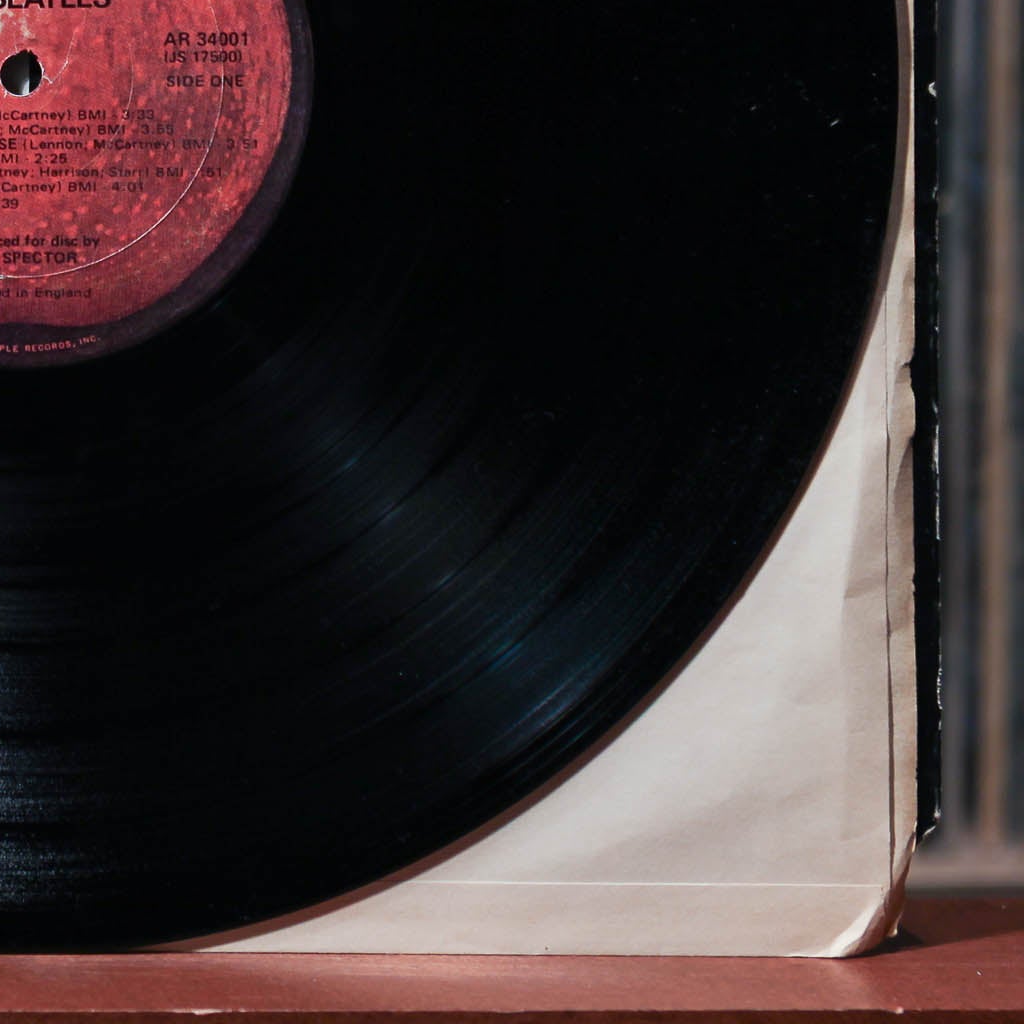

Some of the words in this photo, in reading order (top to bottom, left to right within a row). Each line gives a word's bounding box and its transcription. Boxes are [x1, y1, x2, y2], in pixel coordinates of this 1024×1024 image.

[164, 32, 190, 46] AR
[197, 32, 248, 46] 34001
[166, 75, 204, 87] SIDE
[211, 75, 244, 88] ONE
[78, 110, 106, 120] BMI
[9, 124, 90, 136] McCartney)
[97, 124, 125, 135] BMI
[35, 153, 67, 164] 2:25
[156, 167, 183, 176] BMI
[68, 182, 96, 192] BMI
[25, 235, 45, 247] for
[51, 235, 78, 247] disc
[83, 235, 100, 249] by
[3, 252, 77, 264] SPECTOR
[17, 287, 28, 298] in
[35, 287, 92, 299] England
